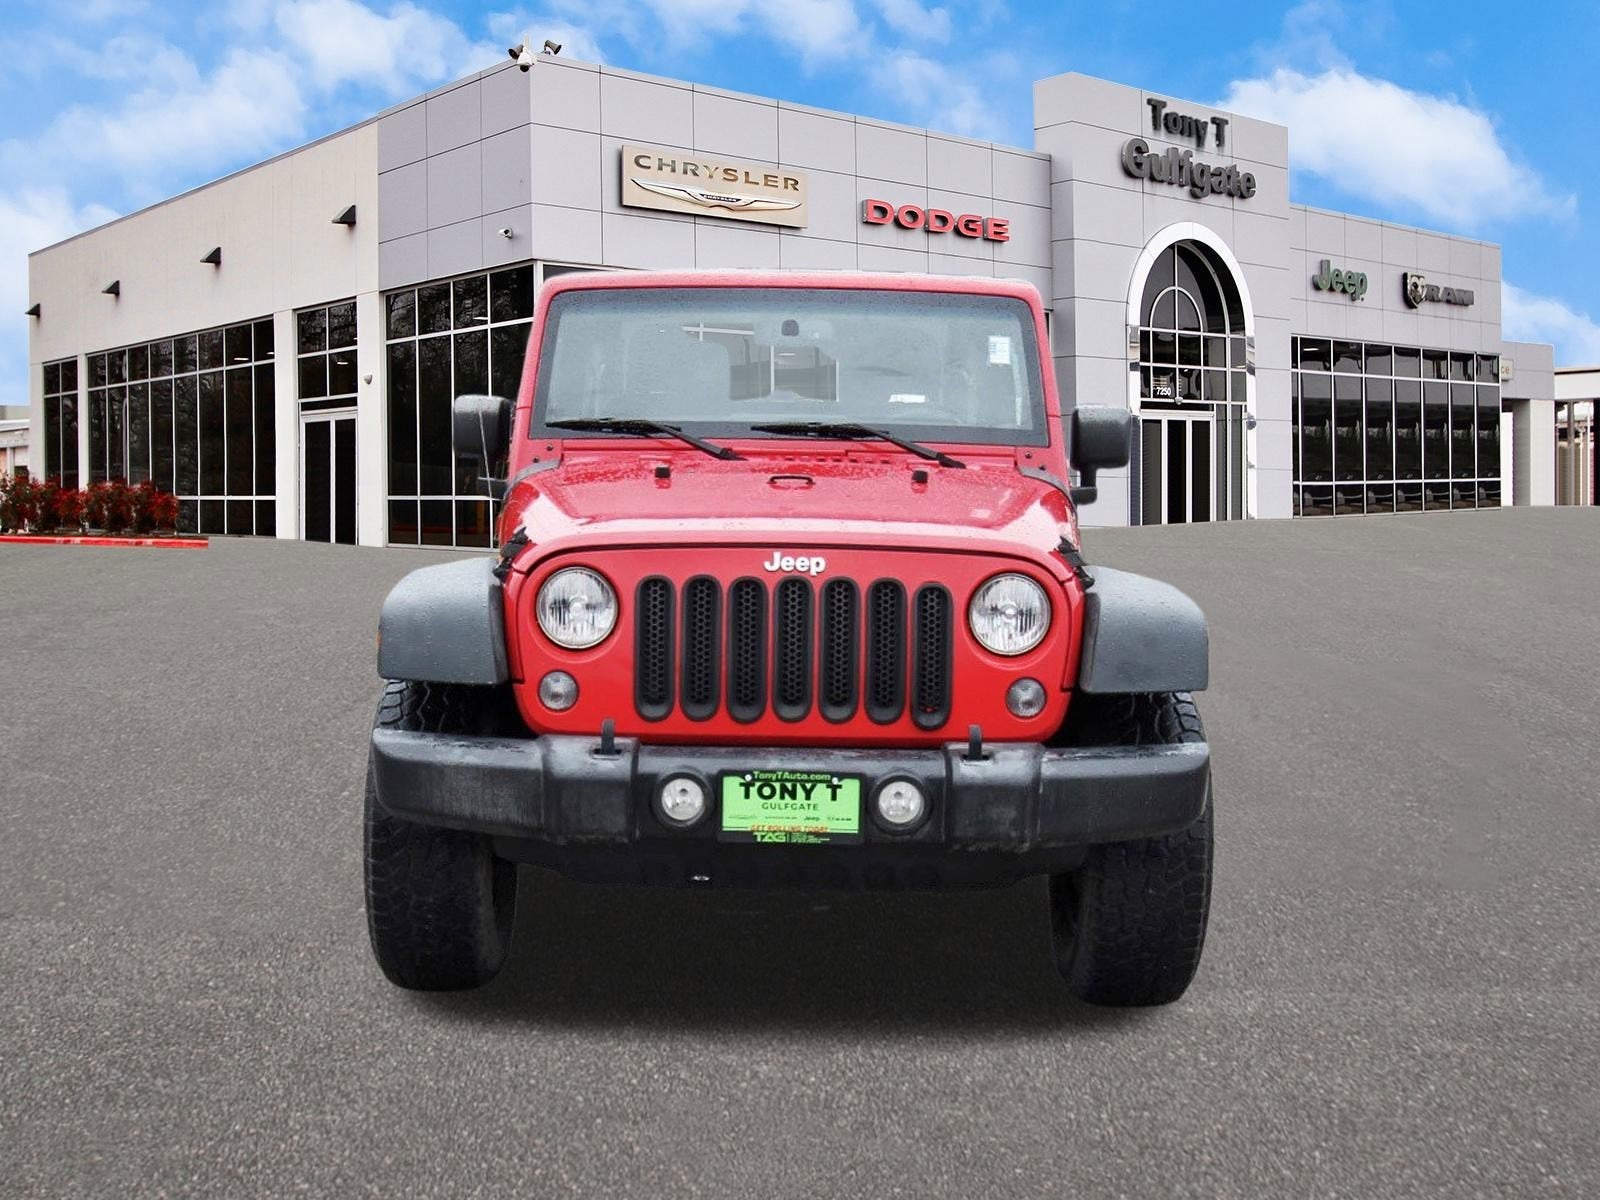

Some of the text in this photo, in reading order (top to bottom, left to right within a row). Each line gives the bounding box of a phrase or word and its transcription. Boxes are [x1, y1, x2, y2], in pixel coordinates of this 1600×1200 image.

[1147, 97, 1229, 148] Tony T
[633, 154, 800, 192] CHRYSLER
[1121, 137, 1257, 199] Gulfgate
[862, 198, 1011, 243] DODGE
[1312, 259, 1368, 301] Jeep
[1425, 284, 1475, 306] RAM
[763, 551, 827, 577] Jeep
[739, 782, 842, 801] TONY T
[753, 771, 831, 781] TonyTAuto.com
[762, 802, 819, 811] GULFGATE
